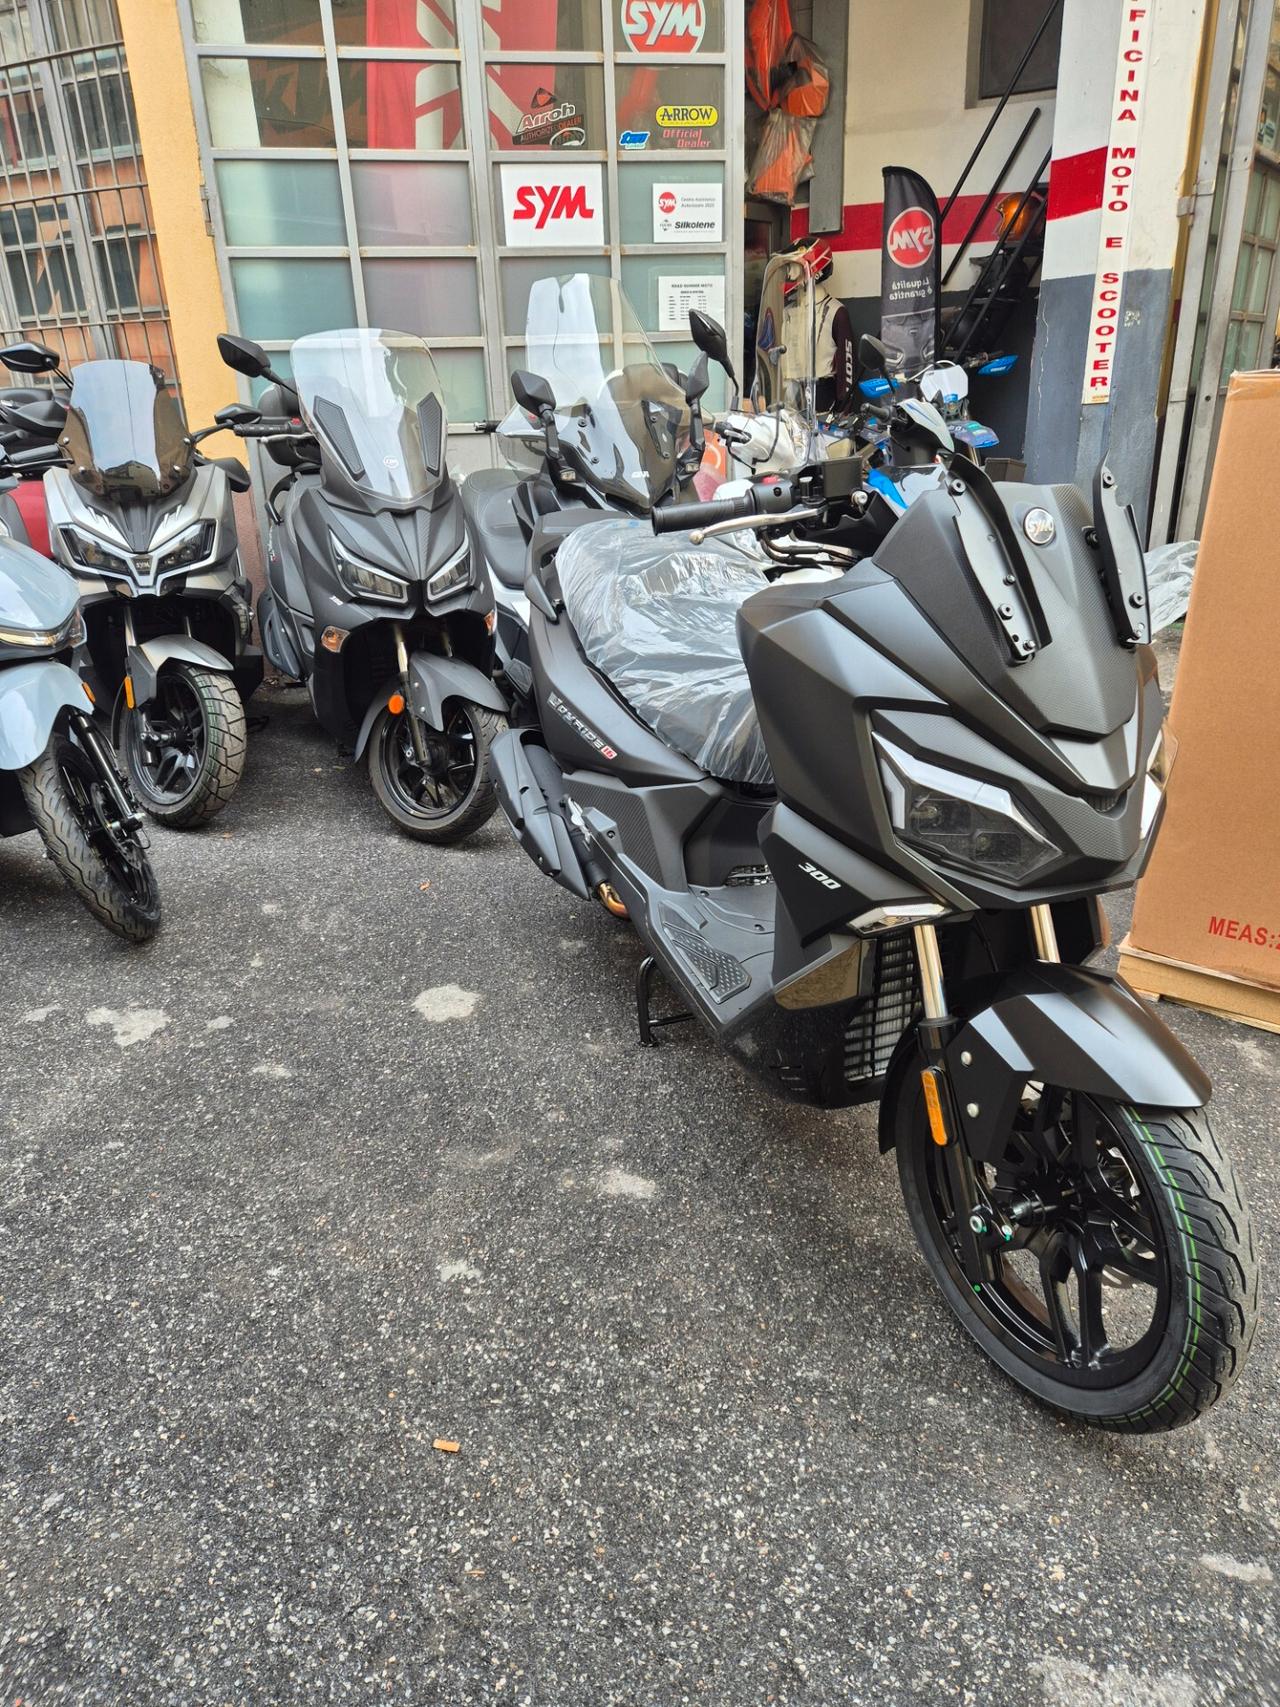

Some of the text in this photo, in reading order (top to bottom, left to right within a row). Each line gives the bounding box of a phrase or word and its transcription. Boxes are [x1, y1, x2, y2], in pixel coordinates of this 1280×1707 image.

[624, 1, 703, 45] SYM
[1117, 0, 1147, 121] FICINA
[660, 107, 713, 121] ARROW
[663, 128, 703, 138] Official
[677, 139, 711, 148] Dealer
[1108, 147, 1136, 212] MOTO
[513, 186, 594, 229] SYM
[659, 198, 676, 210] SYM
[674, 221, 716, 229] Silkolene
[1105, 237, 1123, 248] E
[1090, 272, 1119, 387] SCOOTER
[845, 339, 854, 392] SCOT
[798, 862, 842, 890] 300
